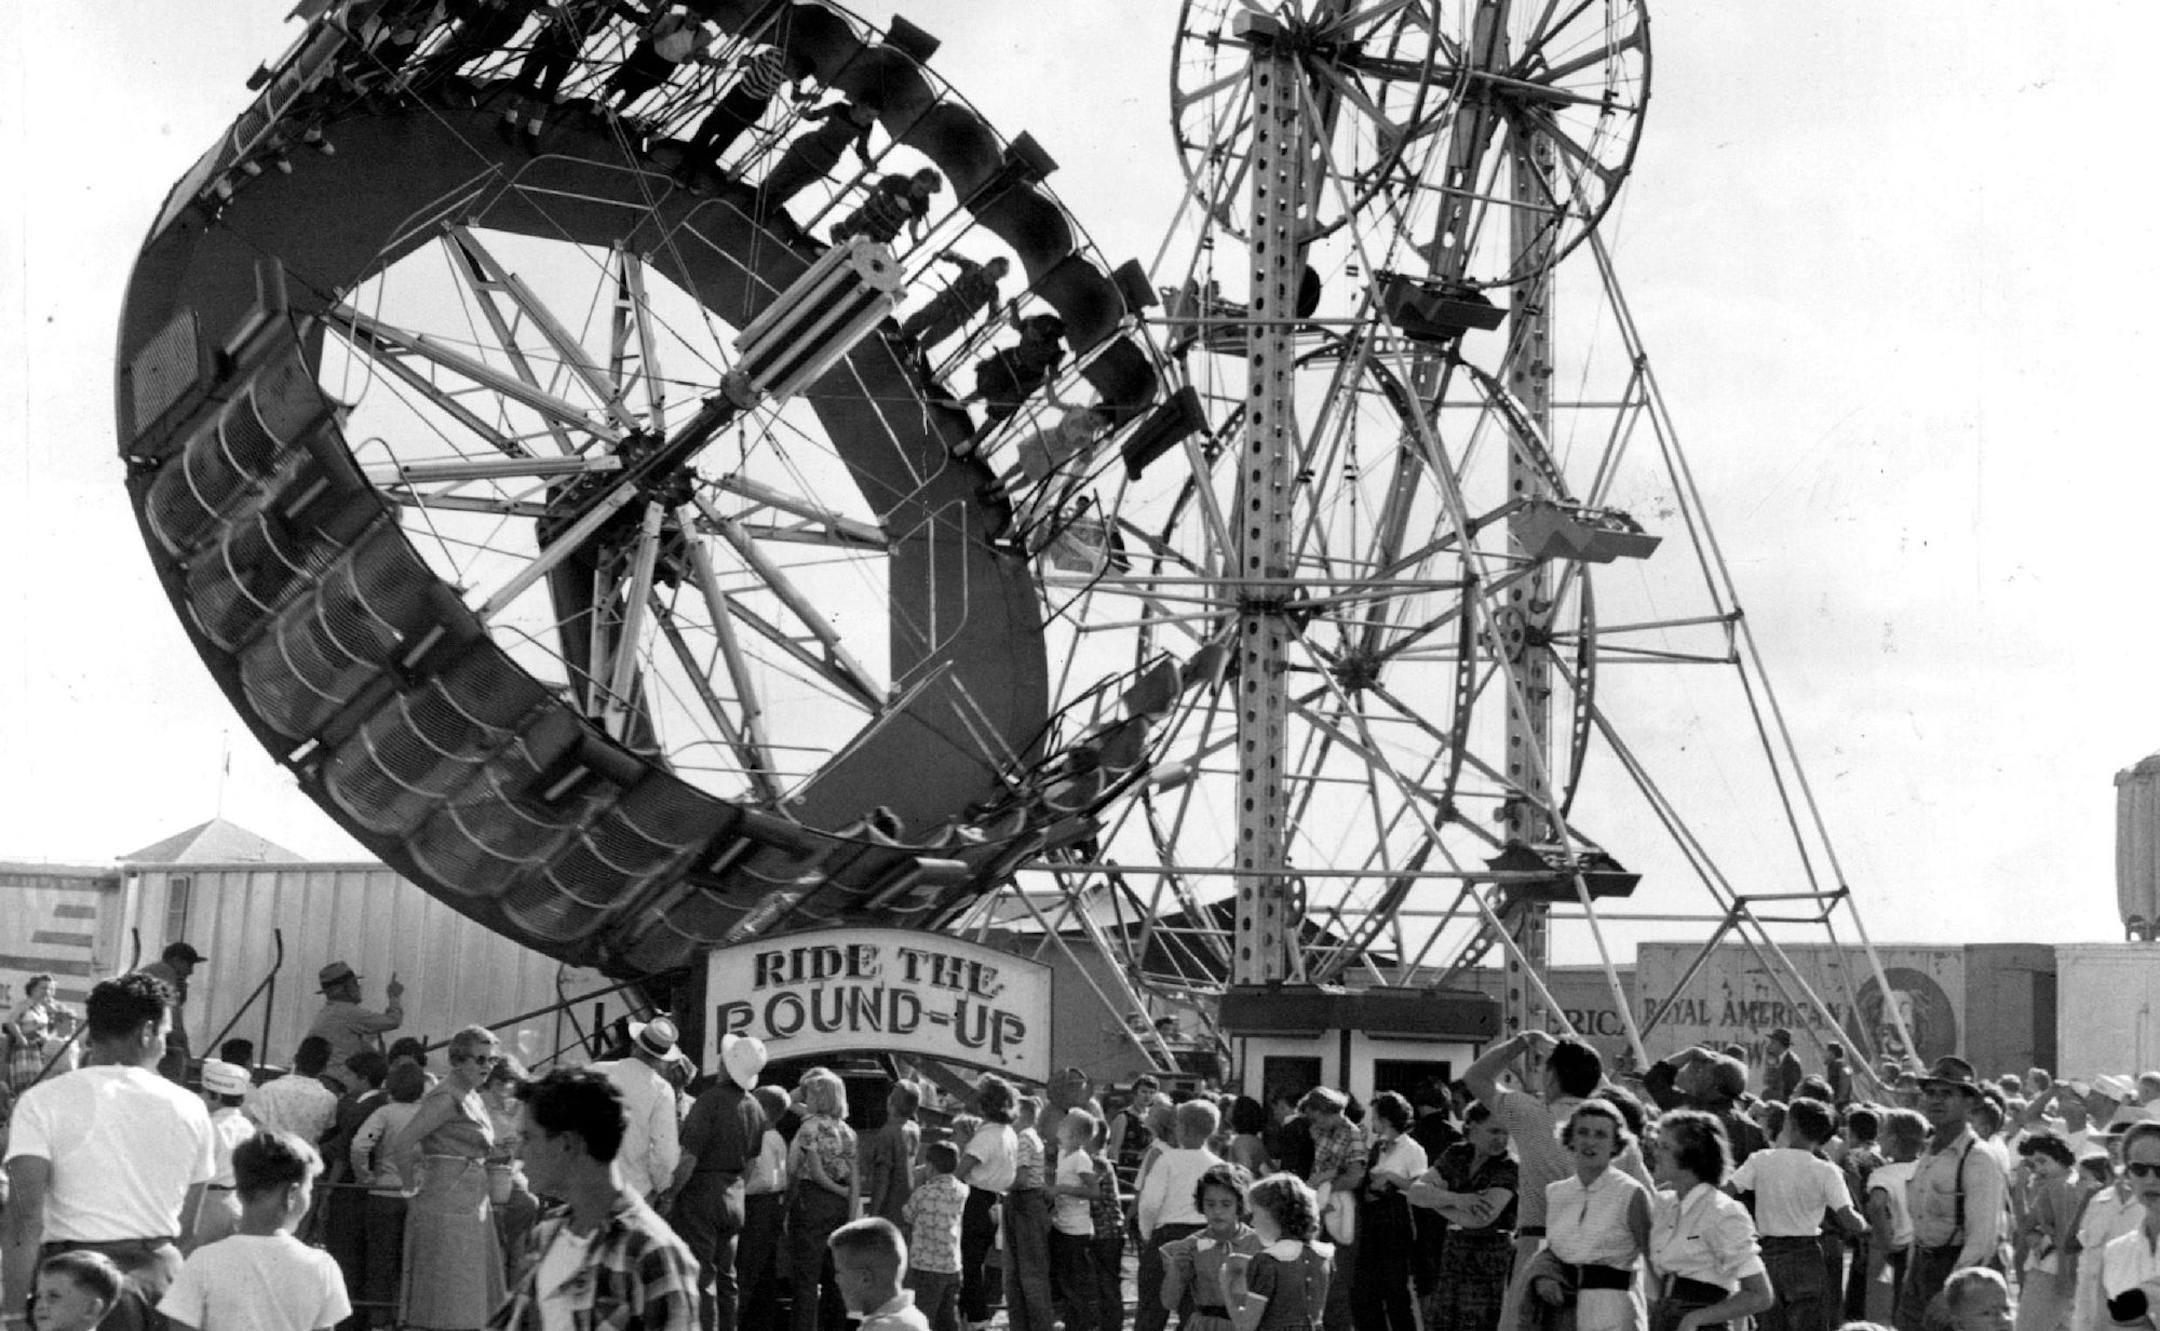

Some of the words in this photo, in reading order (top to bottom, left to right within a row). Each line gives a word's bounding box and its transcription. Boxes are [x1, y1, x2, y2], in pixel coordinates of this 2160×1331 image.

[752, 943, 882, 991] RIDE
[897, 946, 1005, 1000] THE
[716, 985, 1026, 1064] ROUND-UP
